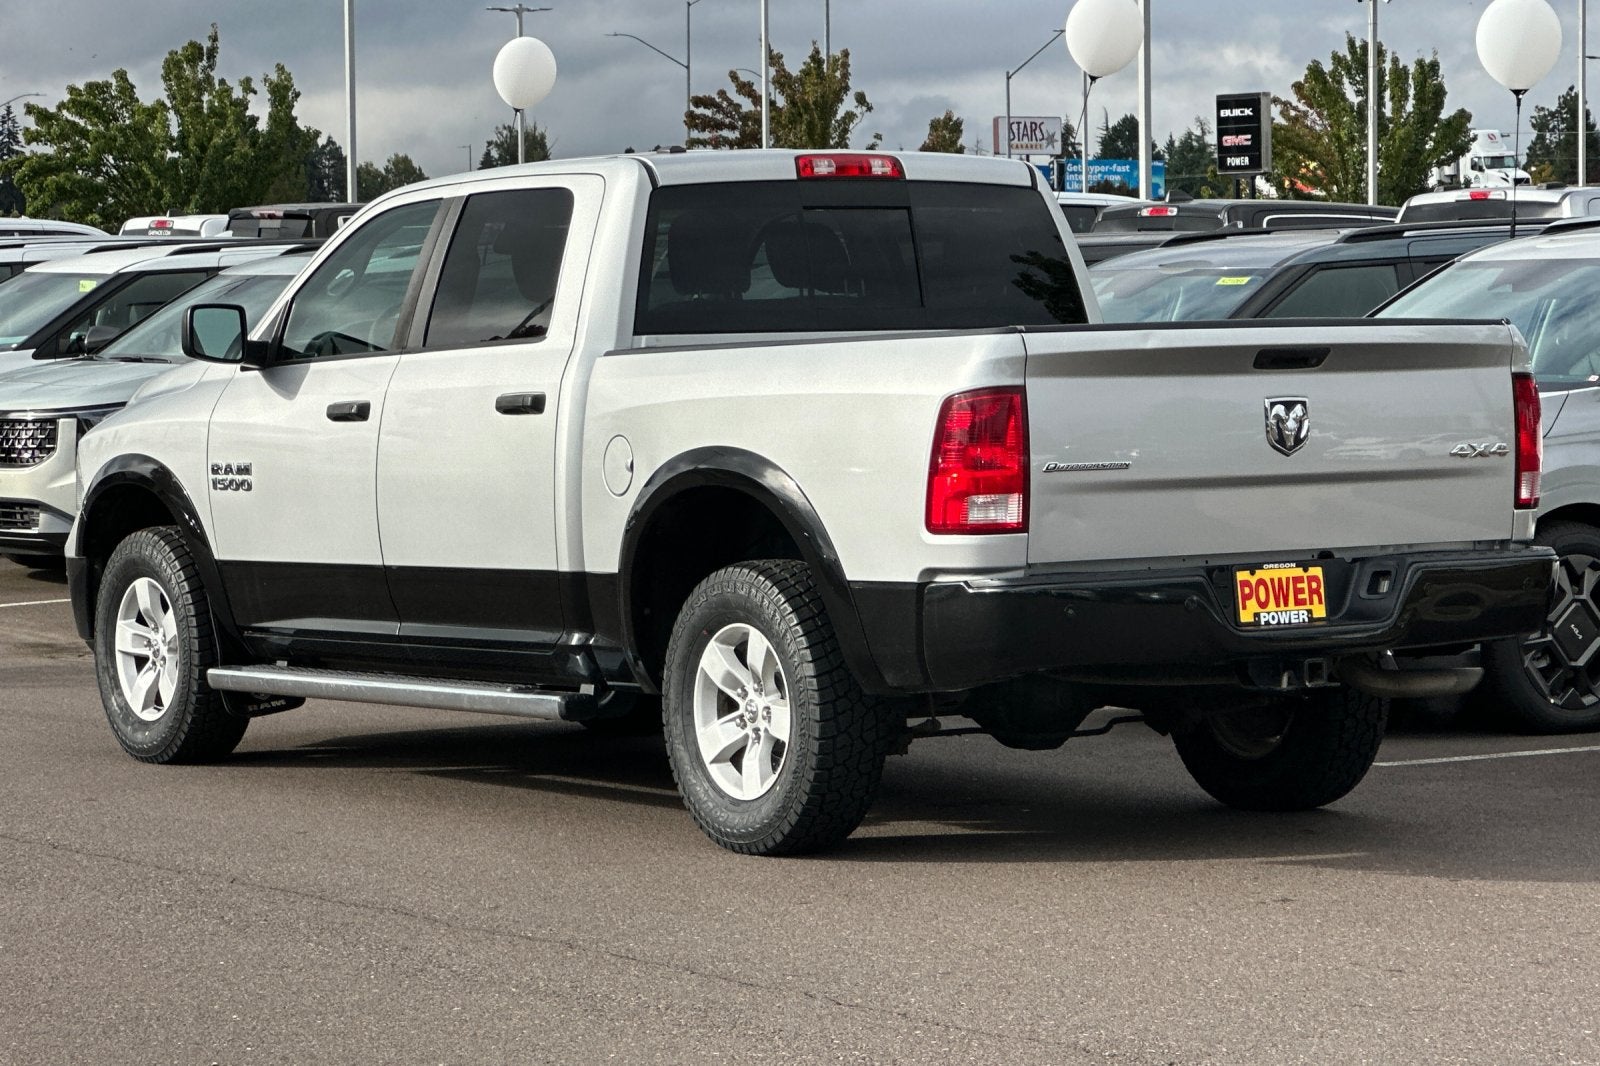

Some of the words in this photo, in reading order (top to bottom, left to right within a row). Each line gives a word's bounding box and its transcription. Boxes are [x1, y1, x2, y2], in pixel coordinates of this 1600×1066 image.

[1220, 107, 1254, 117] BUICK
[1010, 121, 1045, 142] STARS
[1222, 134, 1252, 147] GMC
[1066, 163, 1082, 172] Get
[1226, 156, 1250, 167] POWER
[1066, 173, 1103, 181] intenet
[1066, 181, 1082, 190] Lik
[211, 462, 252, 475] RAM
[211, 478, 252, 491] 1500
[1239, 575, 1323, 610] POWER
[1260, 610, 1309, 625] POWER
